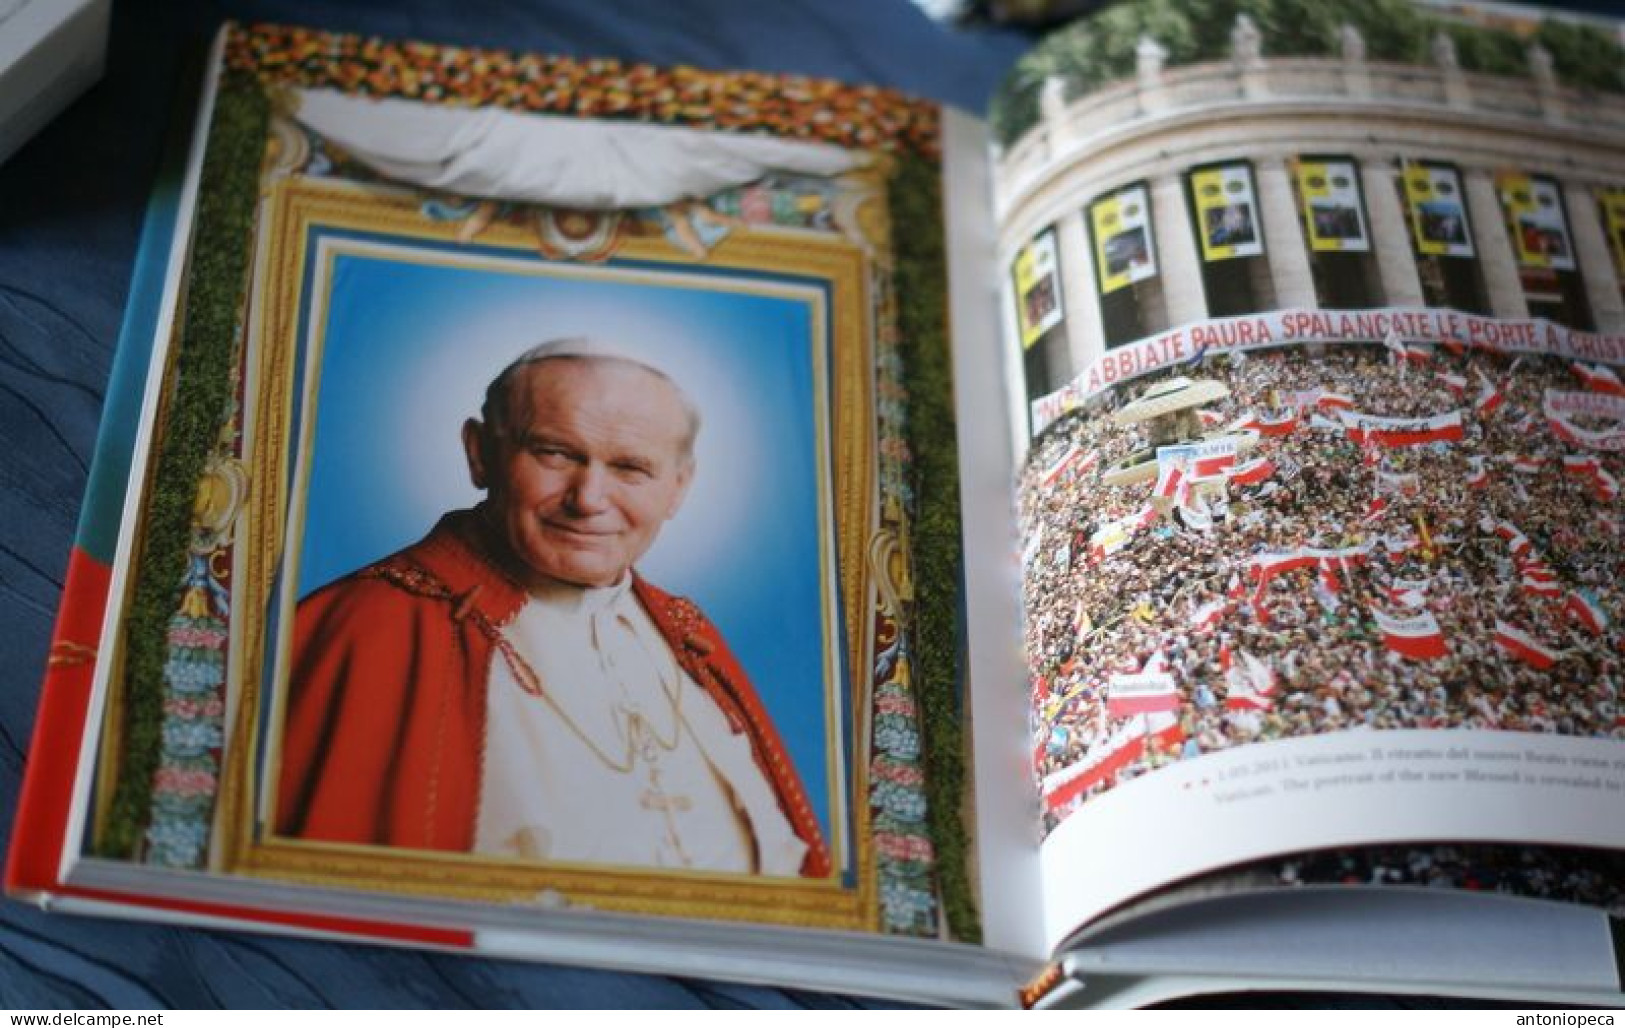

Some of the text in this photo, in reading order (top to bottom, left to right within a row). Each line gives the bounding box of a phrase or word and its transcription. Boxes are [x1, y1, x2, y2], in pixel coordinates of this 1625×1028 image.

[1088, 331, 1186, 392] ABBIATE
[1190, 318, 1273, 351] PAURA
[1281, 311, 1433, 340] SPALANCATE
[1436, 309, 1460, 341] LE
[1466, 318, 1541, 348] PORTE
[1379, 768, 1395, 782] of
[1397, 768, 1424, 781] the
